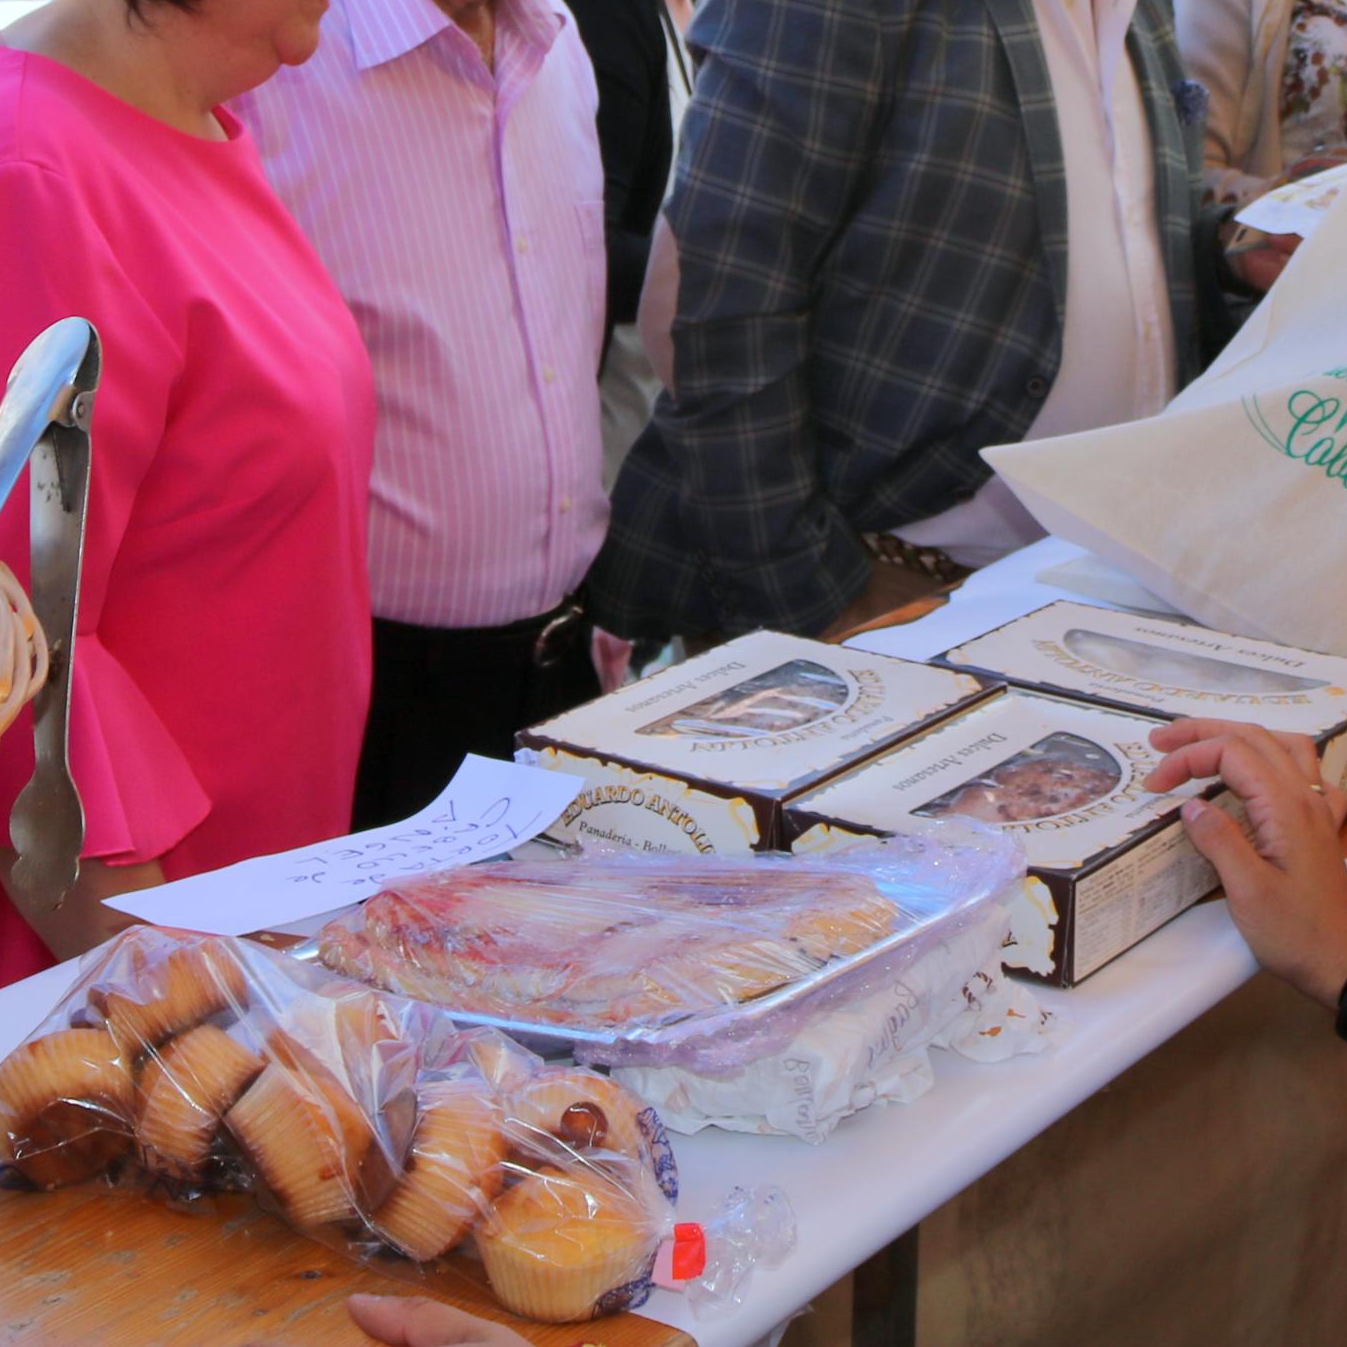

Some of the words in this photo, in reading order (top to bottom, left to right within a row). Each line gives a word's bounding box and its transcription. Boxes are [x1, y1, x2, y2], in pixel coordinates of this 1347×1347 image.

[958, 732, 1008, 762] Dulces
[893, 755, 963, 793] Artesanos
[561, 784, 645, 827] EDUARDO
